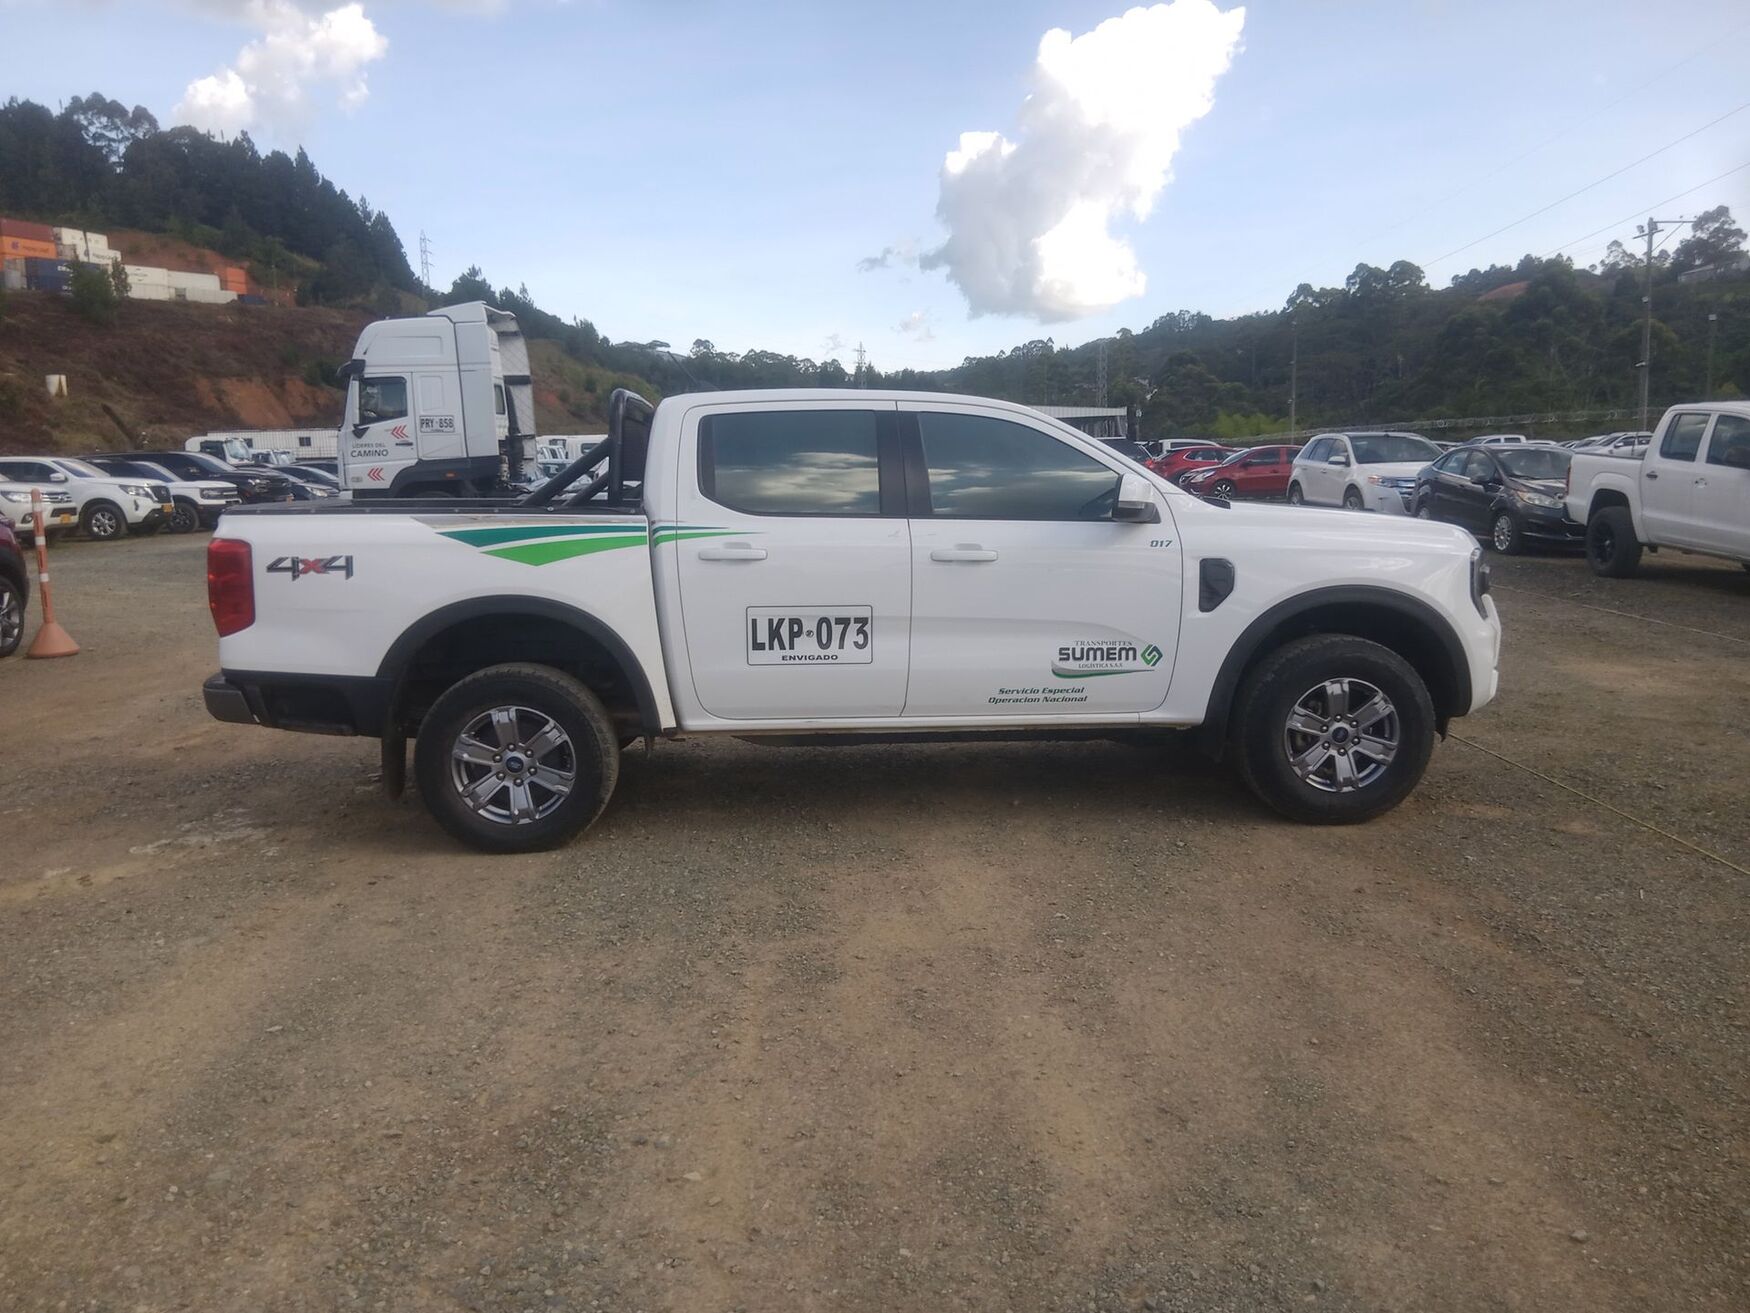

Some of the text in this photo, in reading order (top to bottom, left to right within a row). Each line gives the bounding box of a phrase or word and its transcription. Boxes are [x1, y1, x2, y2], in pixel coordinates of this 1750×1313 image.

[350, 449, 389, 458] CAMINO
[998, 686, 1085, 695] Servicio Especial
[1041, 695, 1088, 703] Nacional
